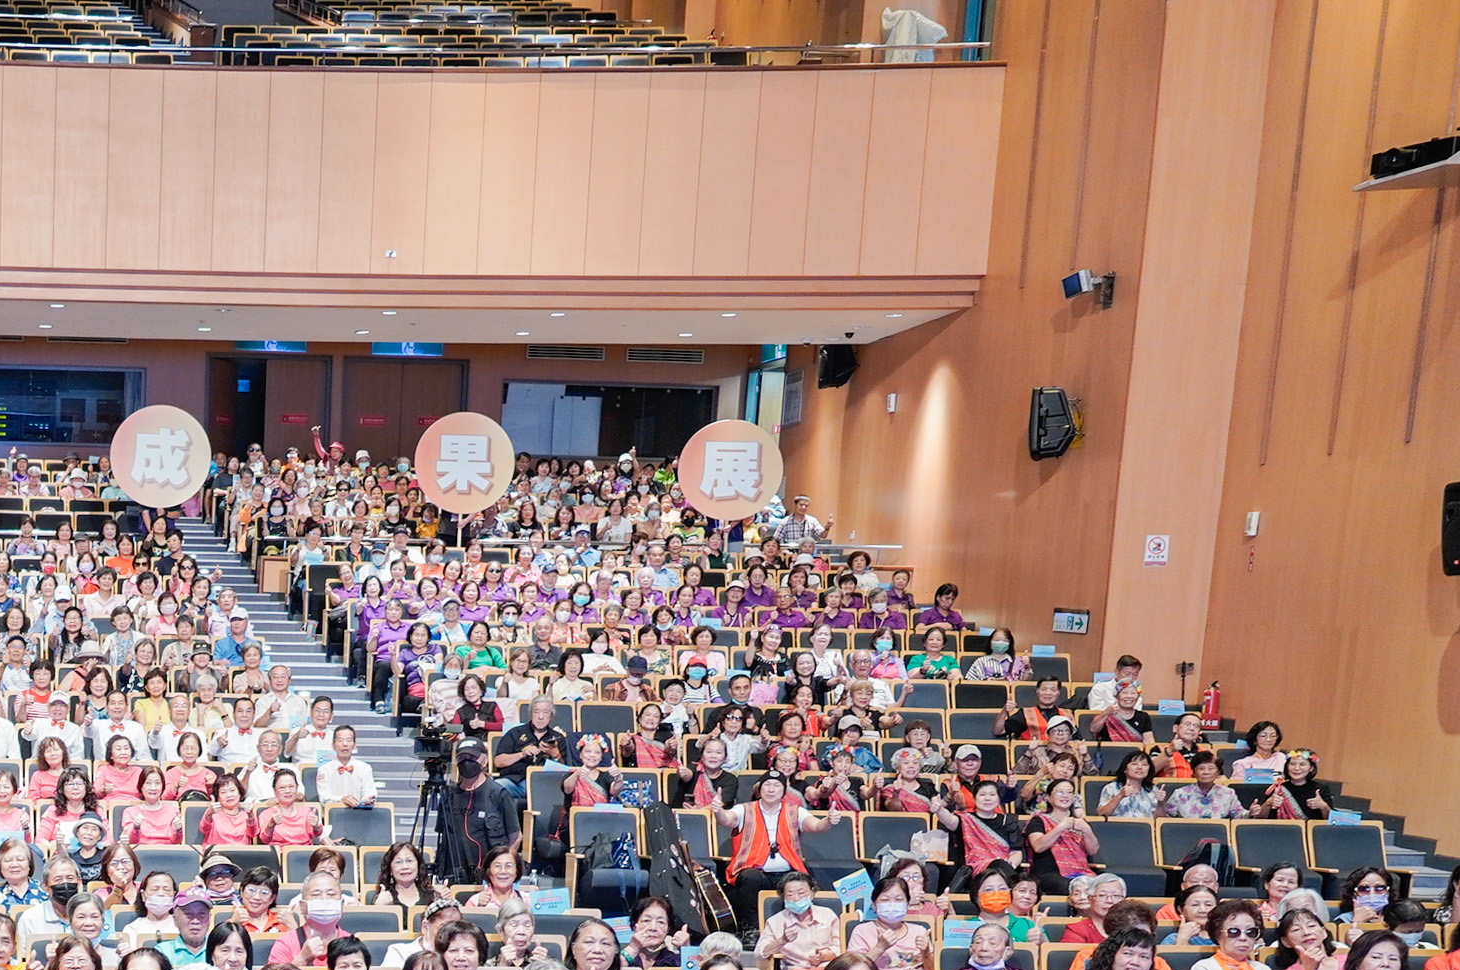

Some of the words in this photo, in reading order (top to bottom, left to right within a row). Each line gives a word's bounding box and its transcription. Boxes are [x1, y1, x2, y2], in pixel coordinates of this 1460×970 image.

[130, 427, 191, 489] 成
[434, 433, 494, 495] 果
[697, 440, 763, 501] 展
